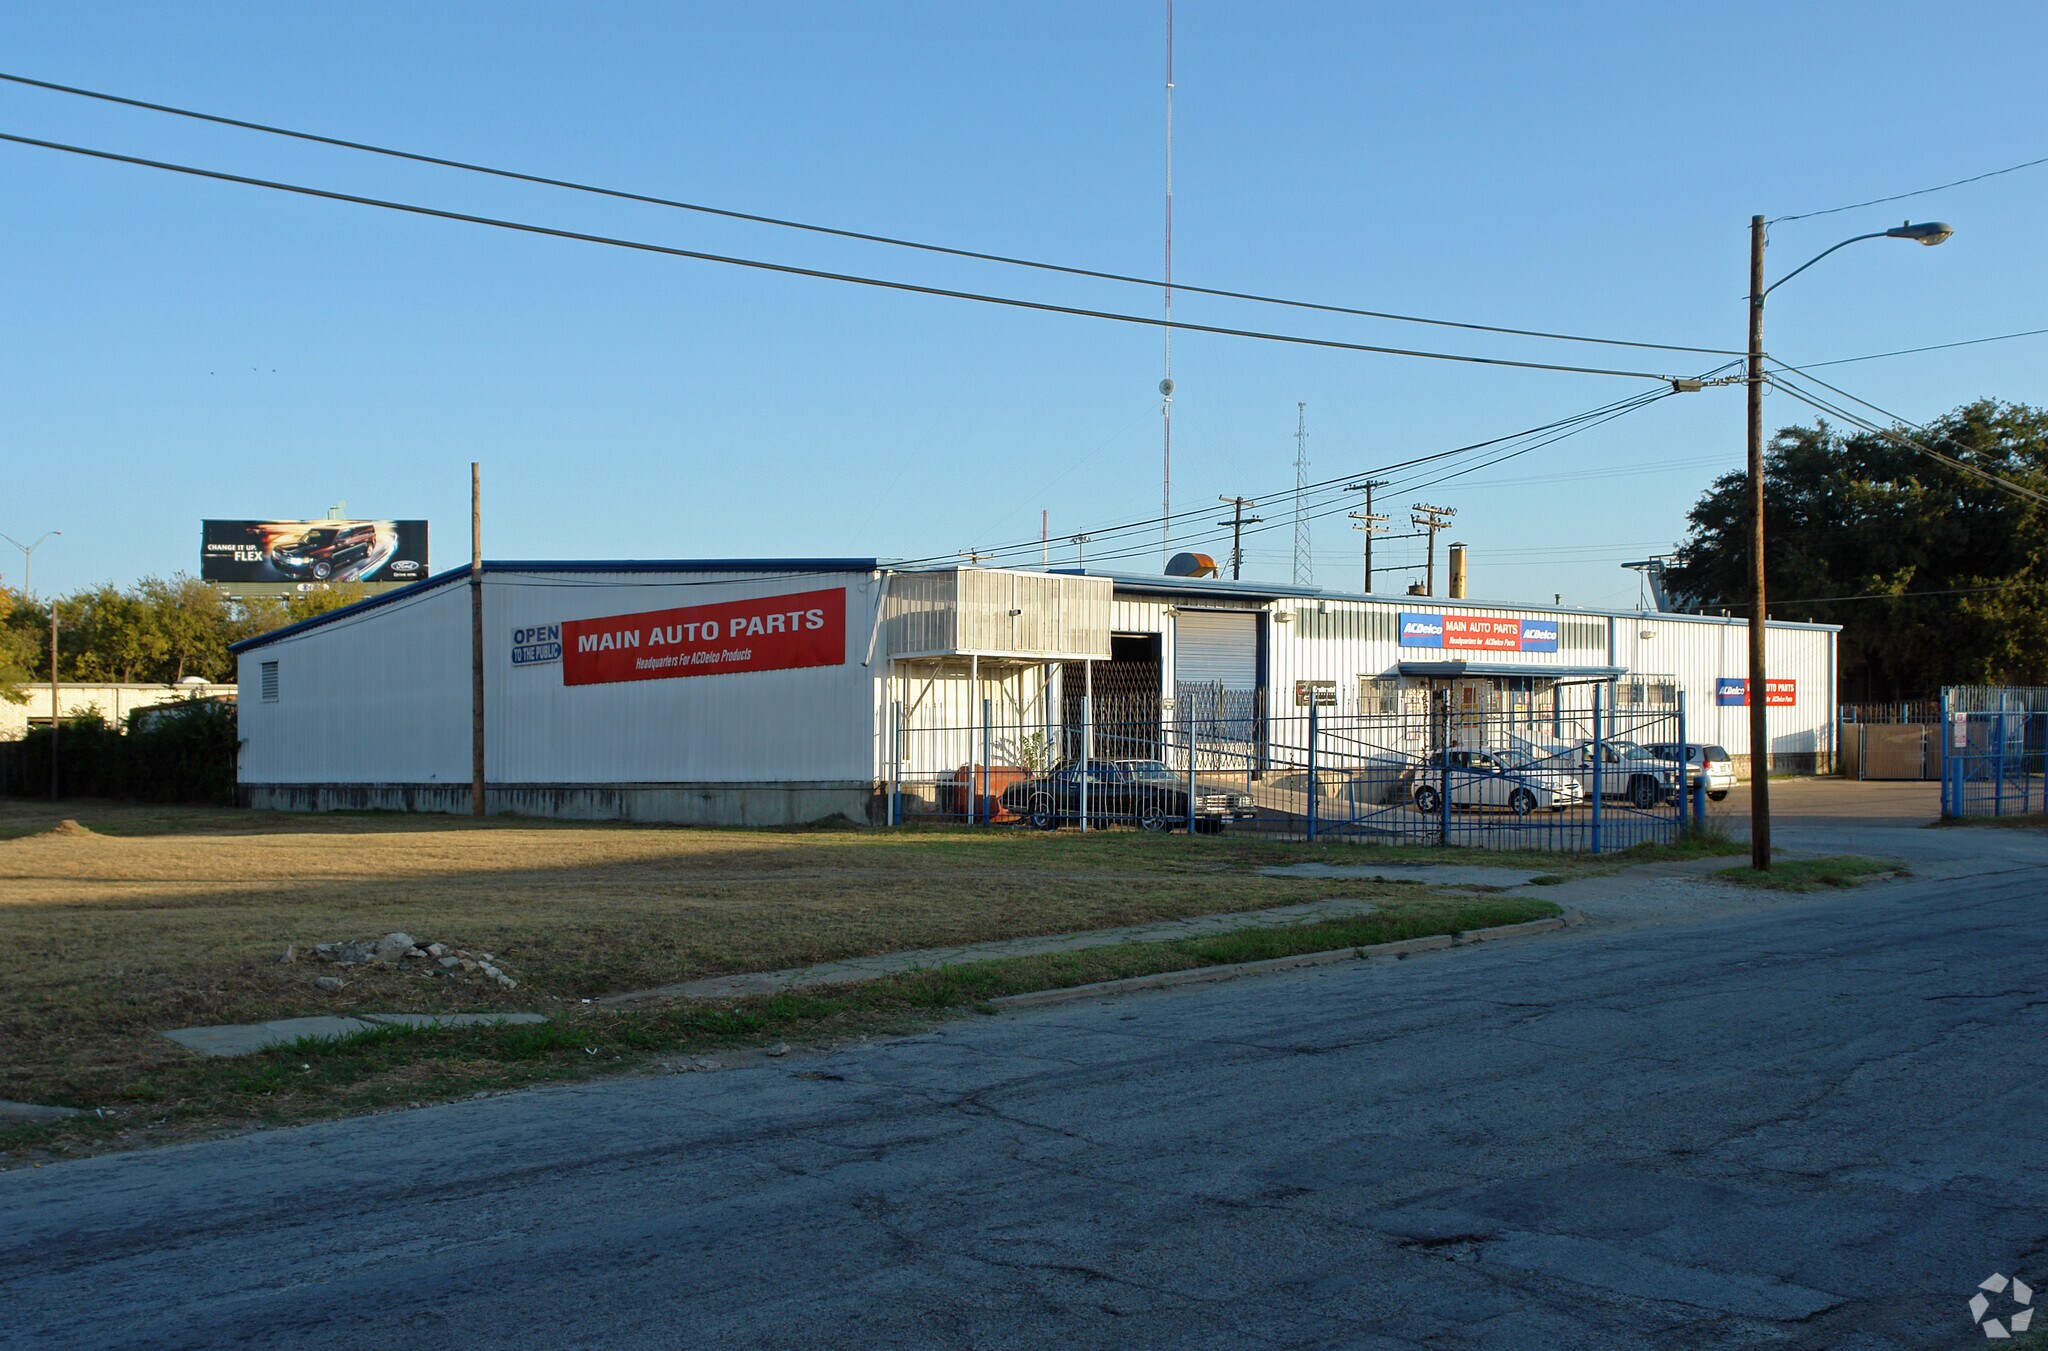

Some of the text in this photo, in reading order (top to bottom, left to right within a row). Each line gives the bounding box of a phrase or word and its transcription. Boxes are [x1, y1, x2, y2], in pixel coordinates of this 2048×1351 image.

[234, 551, 263, 561] FLEX
[513, 624, 559, 645] OPEN
[578, 608, 824, 653] MAIN AUTO PARTS
[1403, 622, 1443, 635] ACDelco
[1445, 621, 1518, 635] MAIN AUTO PARTS
[1523, 628, 1557, 640] ACDelco
[513, 643, 559, 662] TO THE PUBLIC
[635, 647, 752, 671] Headquarters For ACDelco Products
[1719, 686, 1745, 695] ACDelco
[1778, 684, 1795, 692] PARTS
